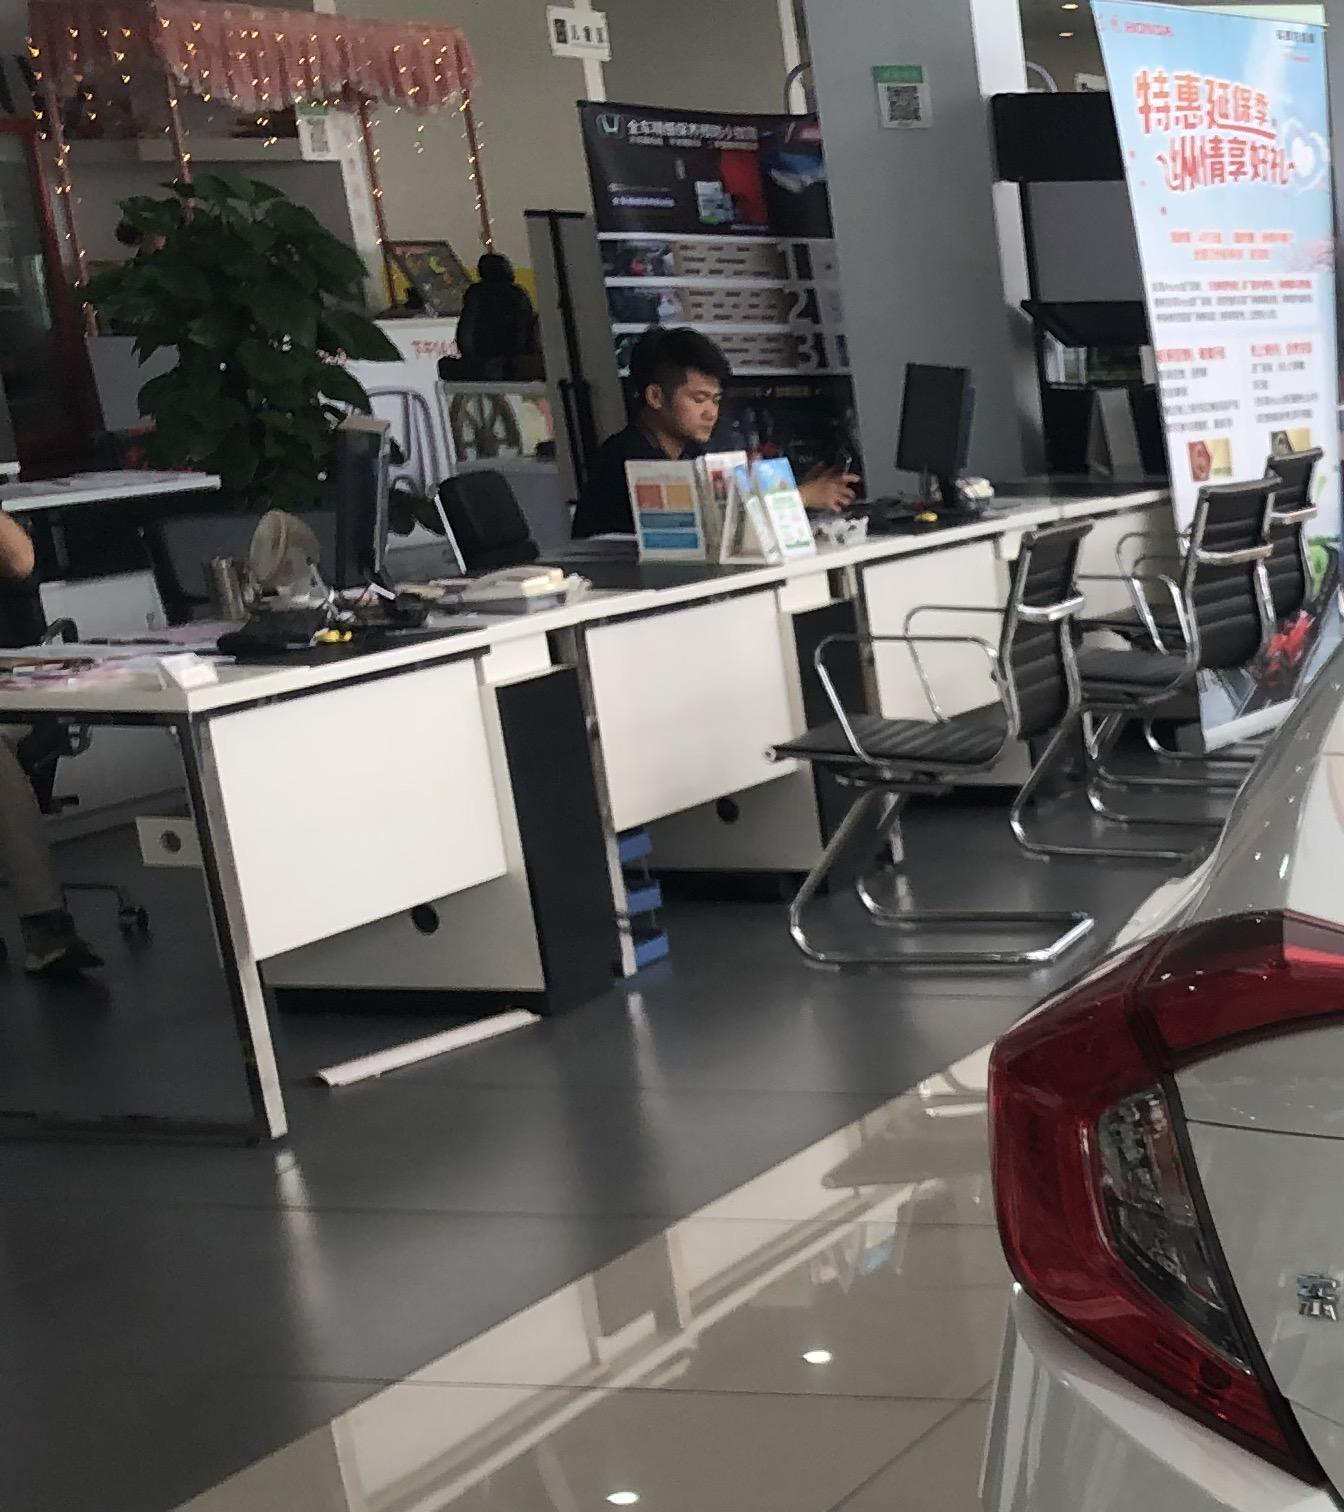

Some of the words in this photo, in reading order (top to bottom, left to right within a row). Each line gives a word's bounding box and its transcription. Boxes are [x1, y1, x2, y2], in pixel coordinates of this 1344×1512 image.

[1135, 69, 1276, 140] 特惠延保季
